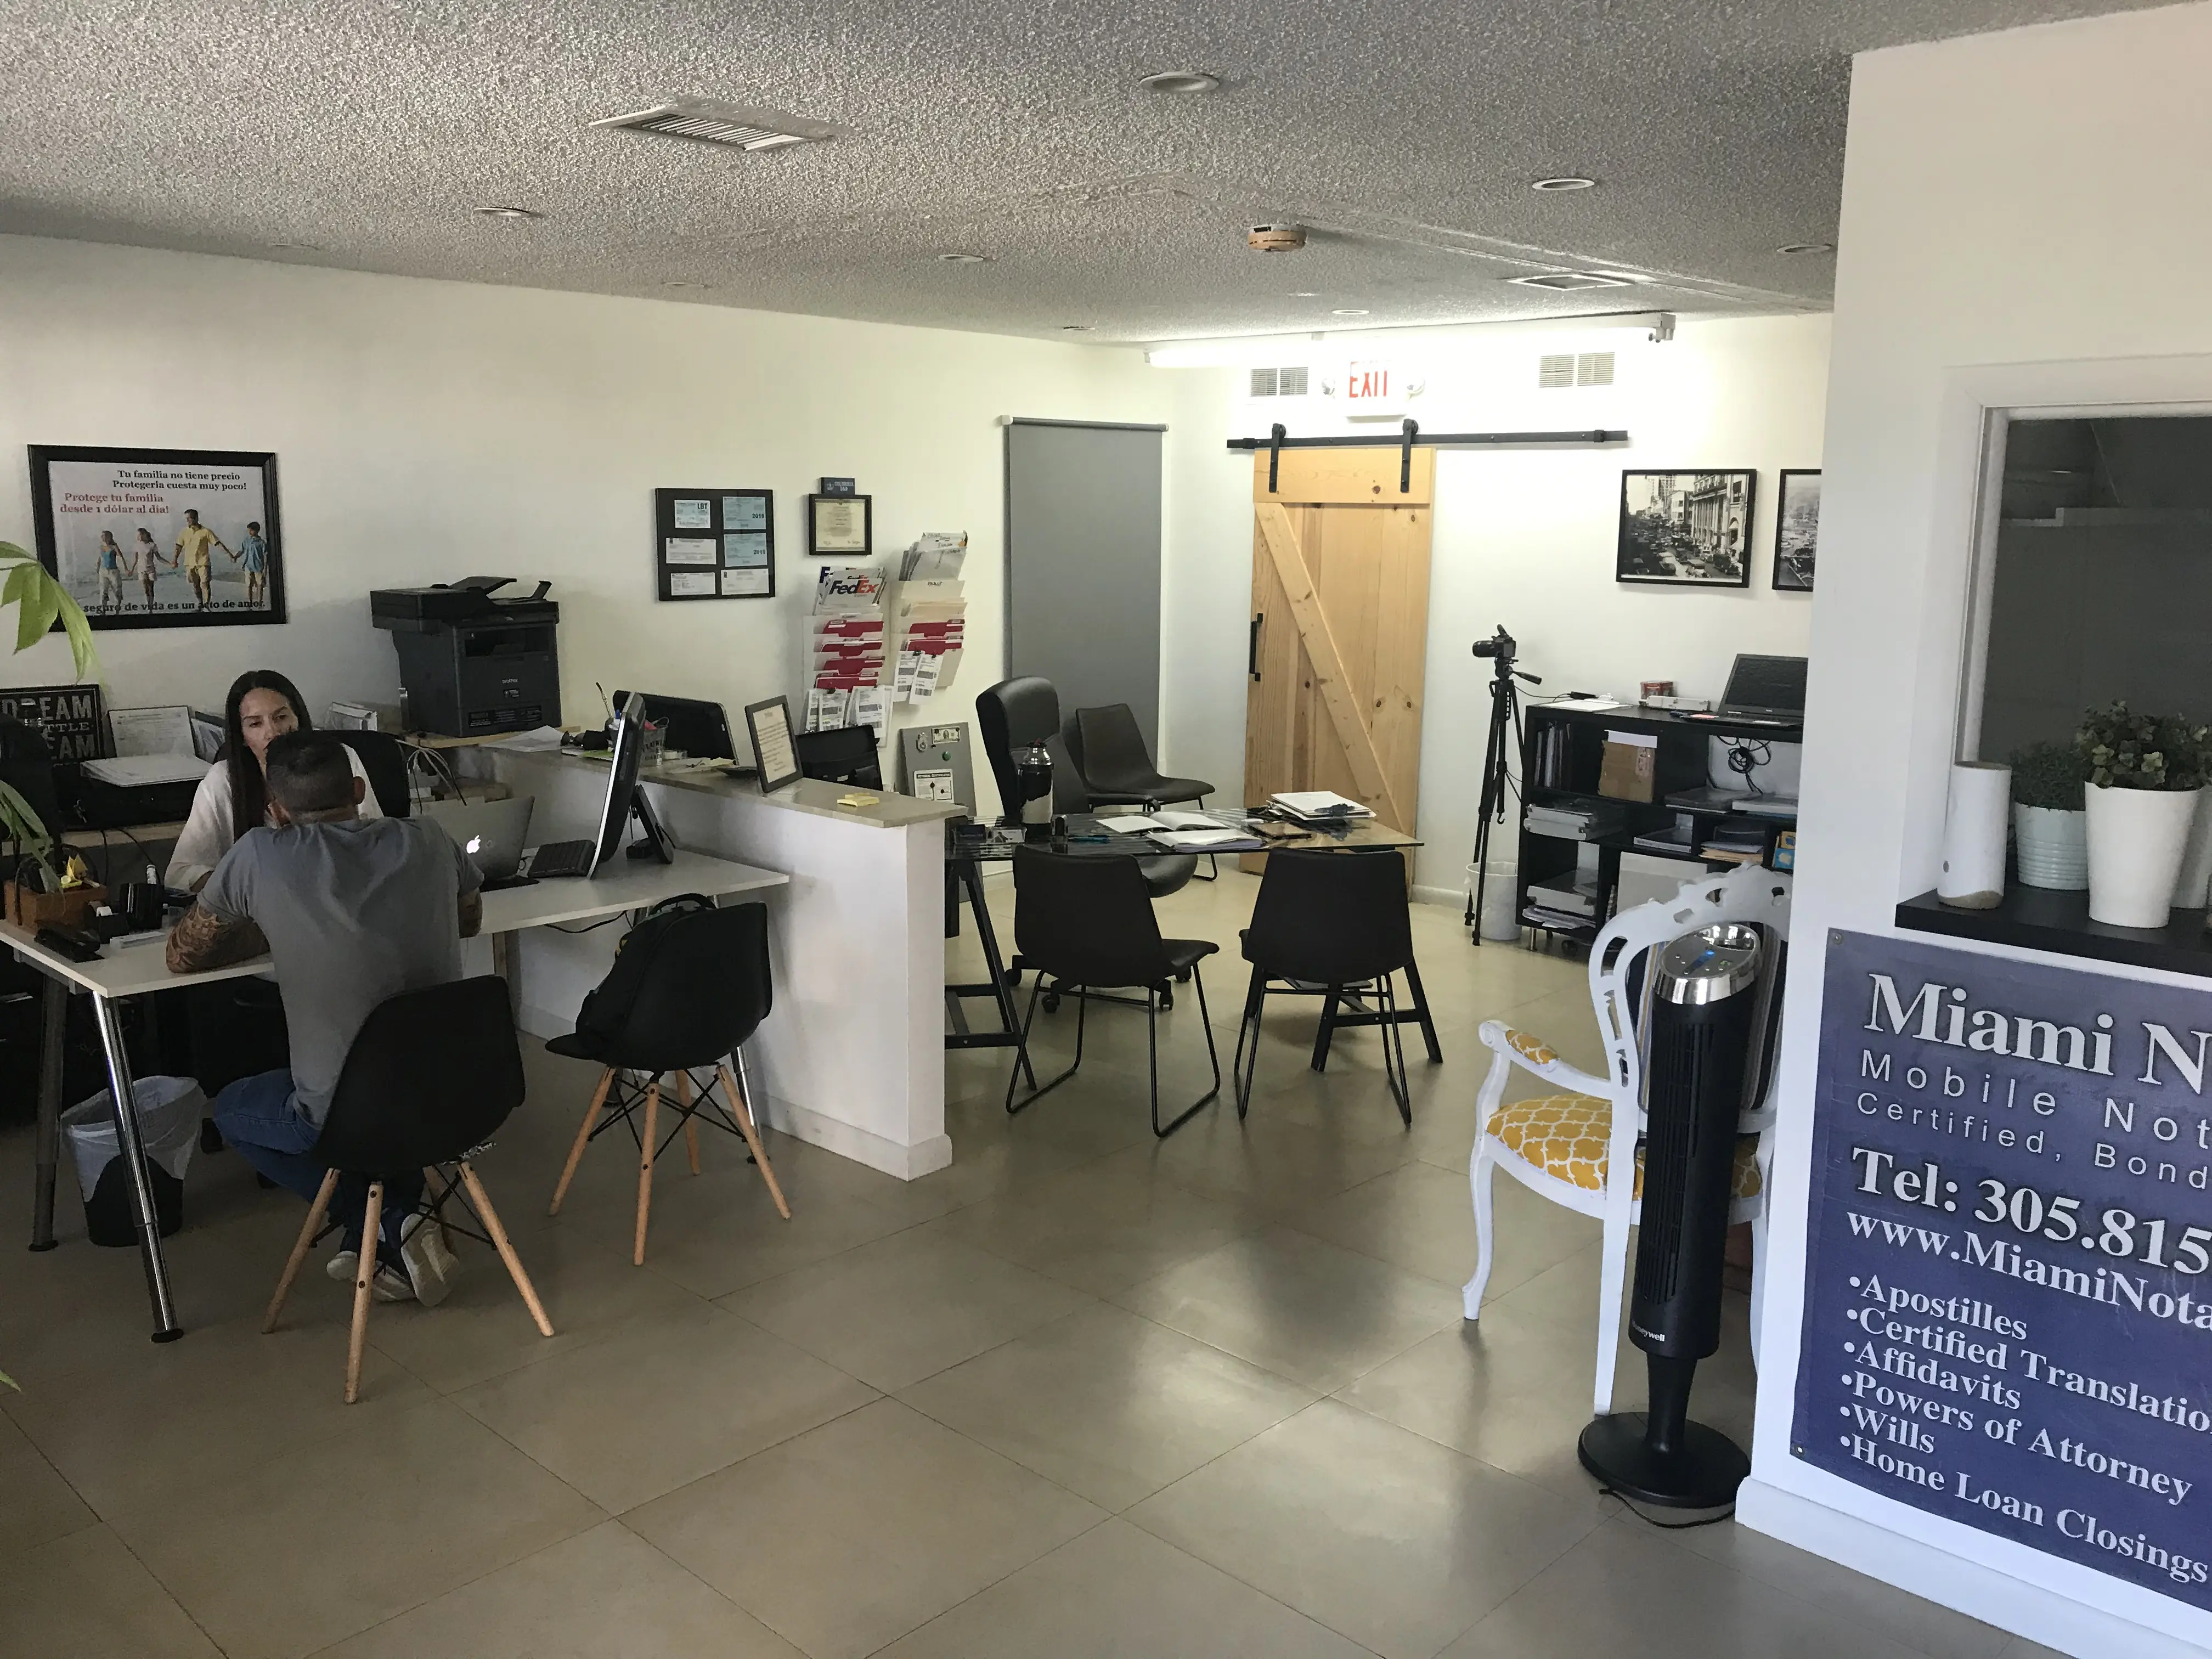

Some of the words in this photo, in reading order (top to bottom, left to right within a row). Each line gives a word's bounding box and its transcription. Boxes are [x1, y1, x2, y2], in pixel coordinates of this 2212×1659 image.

[1348, 360, 1392, 398] EXIT
[60, 504, 93, 513] desde
[136, 505, 146, 514] al
[64, 493, 108, 503] Protege
[125, 493, 163, 502] familia
[112, 480, 164, 490] Protegerla
[166, 481, 198, 489] cuesta
[199, 483, 219, 491] muy
[222, 483, 247, 491] poco!
[133, 470, 167, 478] familia
[185, 471, 209, 479] tiene
[211, 472, 240, 481] precio
[124, 602, 138, 611] de
[141, 601, 165, 611] vida
[222, 600, 236, 608] de
[828, 580, 879, 595] FedEx
[1864, 973, 2114, 1076] Miami
[2137, 1022, 2212, 1094] N
[1861, 1049, 2056, 1115] Mobile
[2104, 1098, 2211, 1149] Not
[1858, 1092, 2062, 1163] Certified,
[2095, 1143, 2208, 1189] Bond
[1853, 1147, 1959, 1212] Tel:
[1974, 1180, 2212, 1274] 305.815
[1847, 1211, 2212, 1331] www.MiamiNota
[1860, 1274, 2027, 1340] Apostilles
[1855, 1340, 2021, 1410] Affidavits
[1860, 1307, 2007, 1370] Certified
[2021, 1349, 2212, 1432] Translatio
[1851, 1403, 1934, 1453] Wills
[1852, 1370, 1973, 1431] Powers
[1984, 1418, 2022, 1446] of
[2027, 1428, 2193, 1506] Attorney
[1851, 1433, 1945, 1491] Home
[1954, 1471, 2044, 1527] Loan
[2057, 1509, 2208, 1583] Closings
